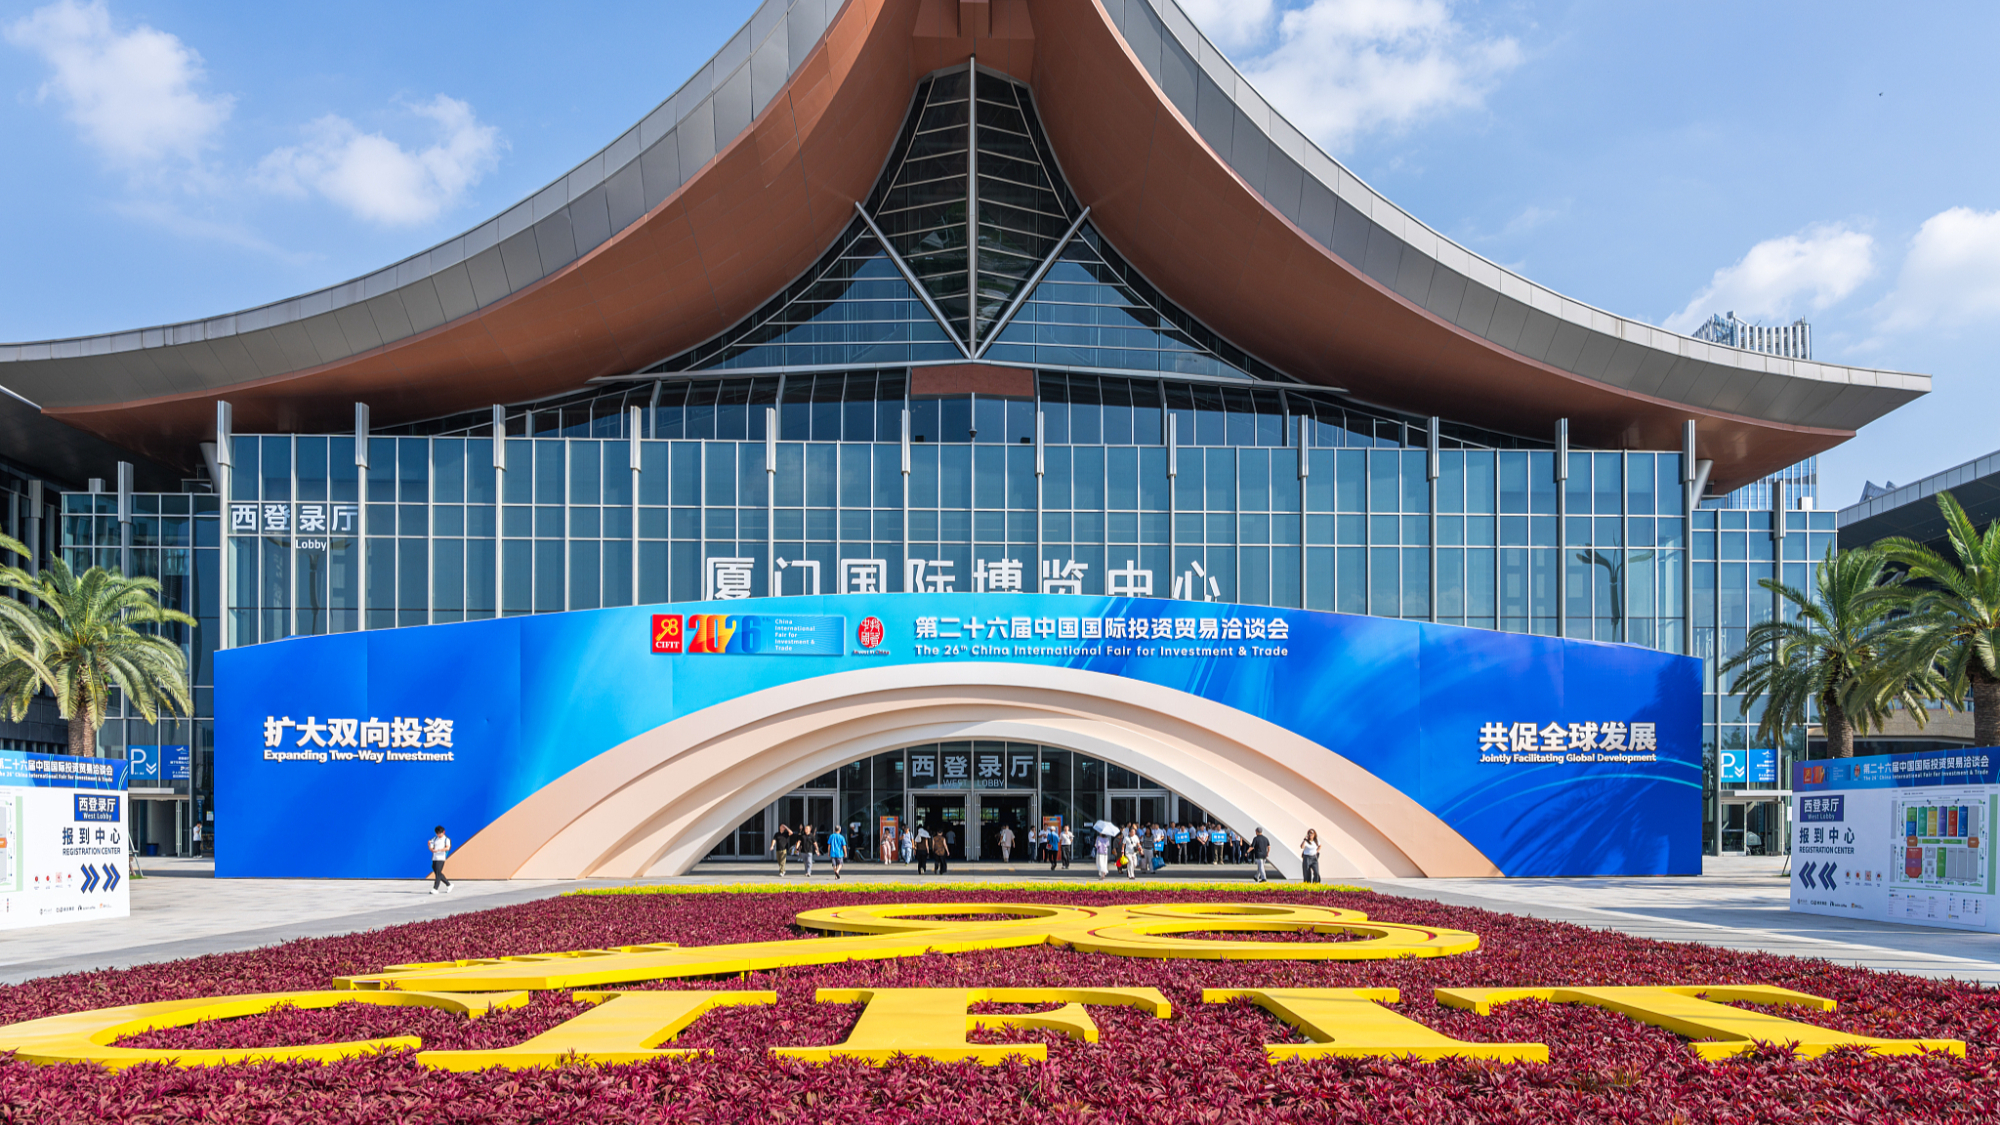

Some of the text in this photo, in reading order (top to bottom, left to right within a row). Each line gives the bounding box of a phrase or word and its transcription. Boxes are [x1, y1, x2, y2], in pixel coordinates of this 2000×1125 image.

[230, 504, 358, 531] 西登录厅
[295, 538, 327, 552] Lobby
[705, 556, 1222, 601] 厦门国际博览中心
[687, 614, 762, 653] 2026
[915, 616, 1289, 640] 第二十六届中国国际投资贸易洽谈会
[655, 641, 680, 649] CIFIT
[915, 644, 1288, 656] The 26th China International Fair for Investment & Trade
[263, 715, 454, 748] 扩大双向投资
[1478, 721, 1657, 752] 共促全球发展
[130, 748, 147, 775] P
[263, 750, 454, 764] Expanding Two-Way Investment
[1479, 753, 1657, 764] Jointly Facilitating Global Development
[1720, 752, 1736, 778] P
[911, 755, 1034, 778] 西登录厅
[942, 779, 1005, 787] WEST LOBBY
[78, 796, 116, 812] 西登录厅
[1804, 798, 1840, 814] 西登录厅
[96, 812, 112, 821] Lobby
[62, 826, 120, 846] 报到中心
[1799, 826, 1855, 844] 报到中心
[62, 847, 120, 856] REGISTRATION CENTER
[1799, 846, 1855, 854] REGISTRATION CENTER
[0, 984, 1967, 1071] CIFIT
